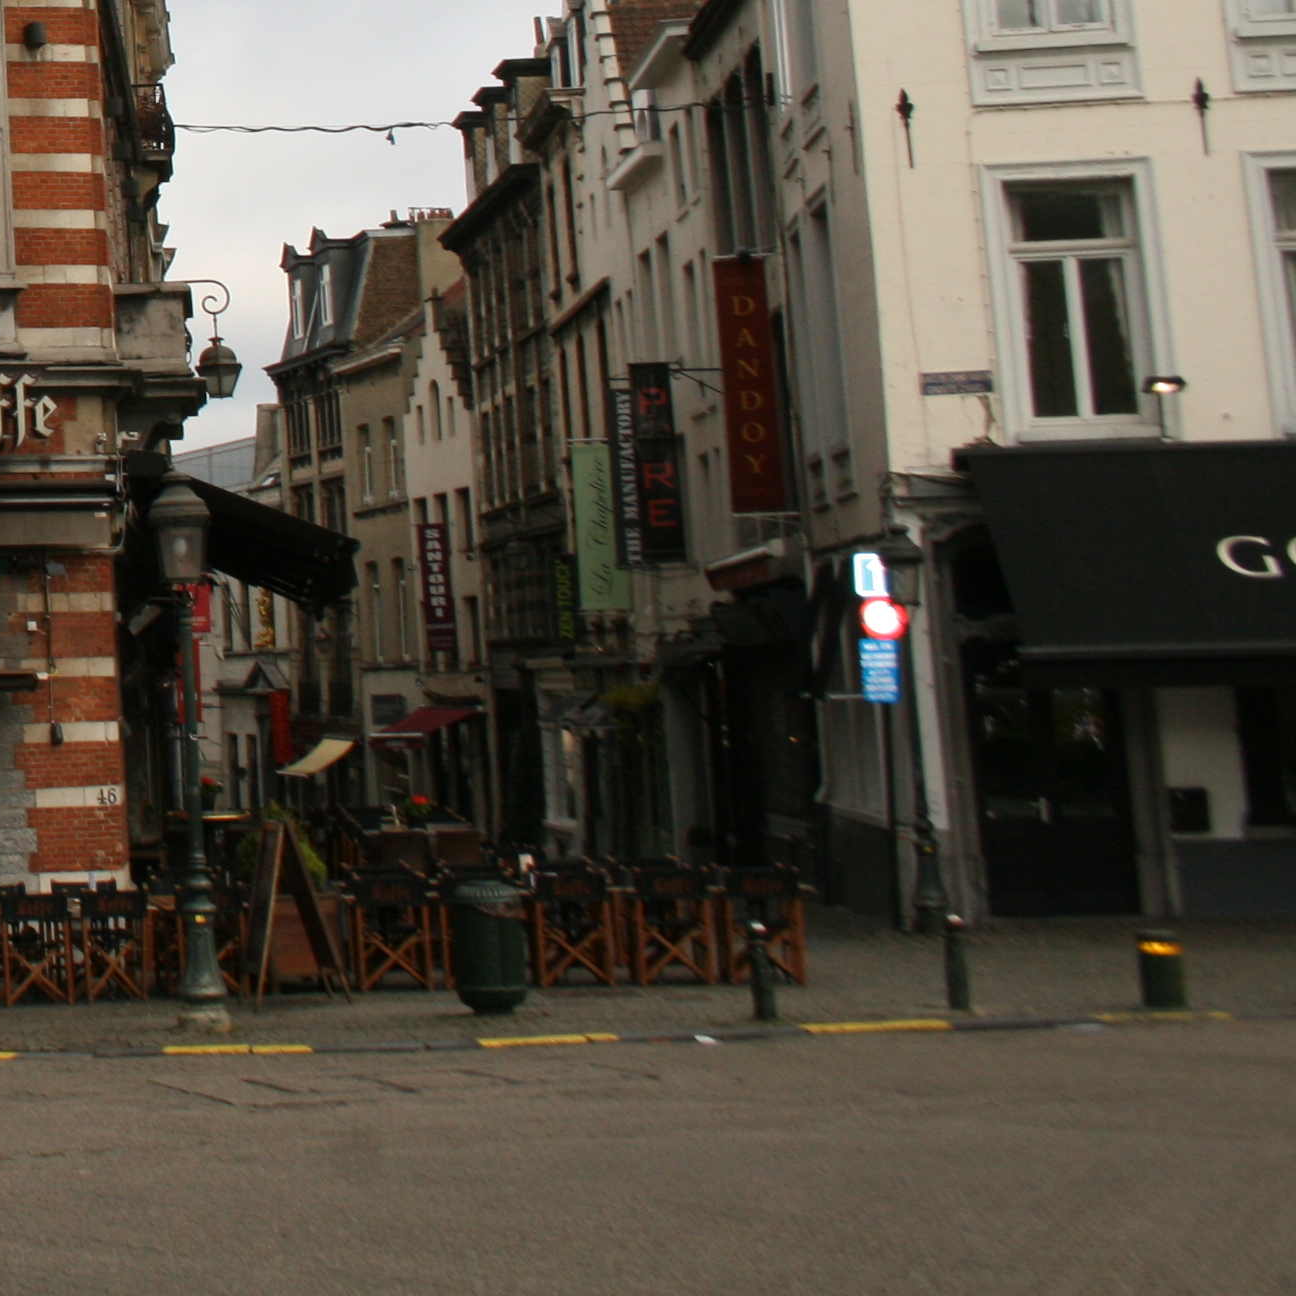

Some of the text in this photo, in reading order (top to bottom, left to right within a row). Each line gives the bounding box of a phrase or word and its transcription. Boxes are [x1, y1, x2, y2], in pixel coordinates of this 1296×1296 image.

[732, 293, 762, 476] DANDOY
[423, 528, 447, 618] SANTOURI
[96, 787, 118, 806] 46
